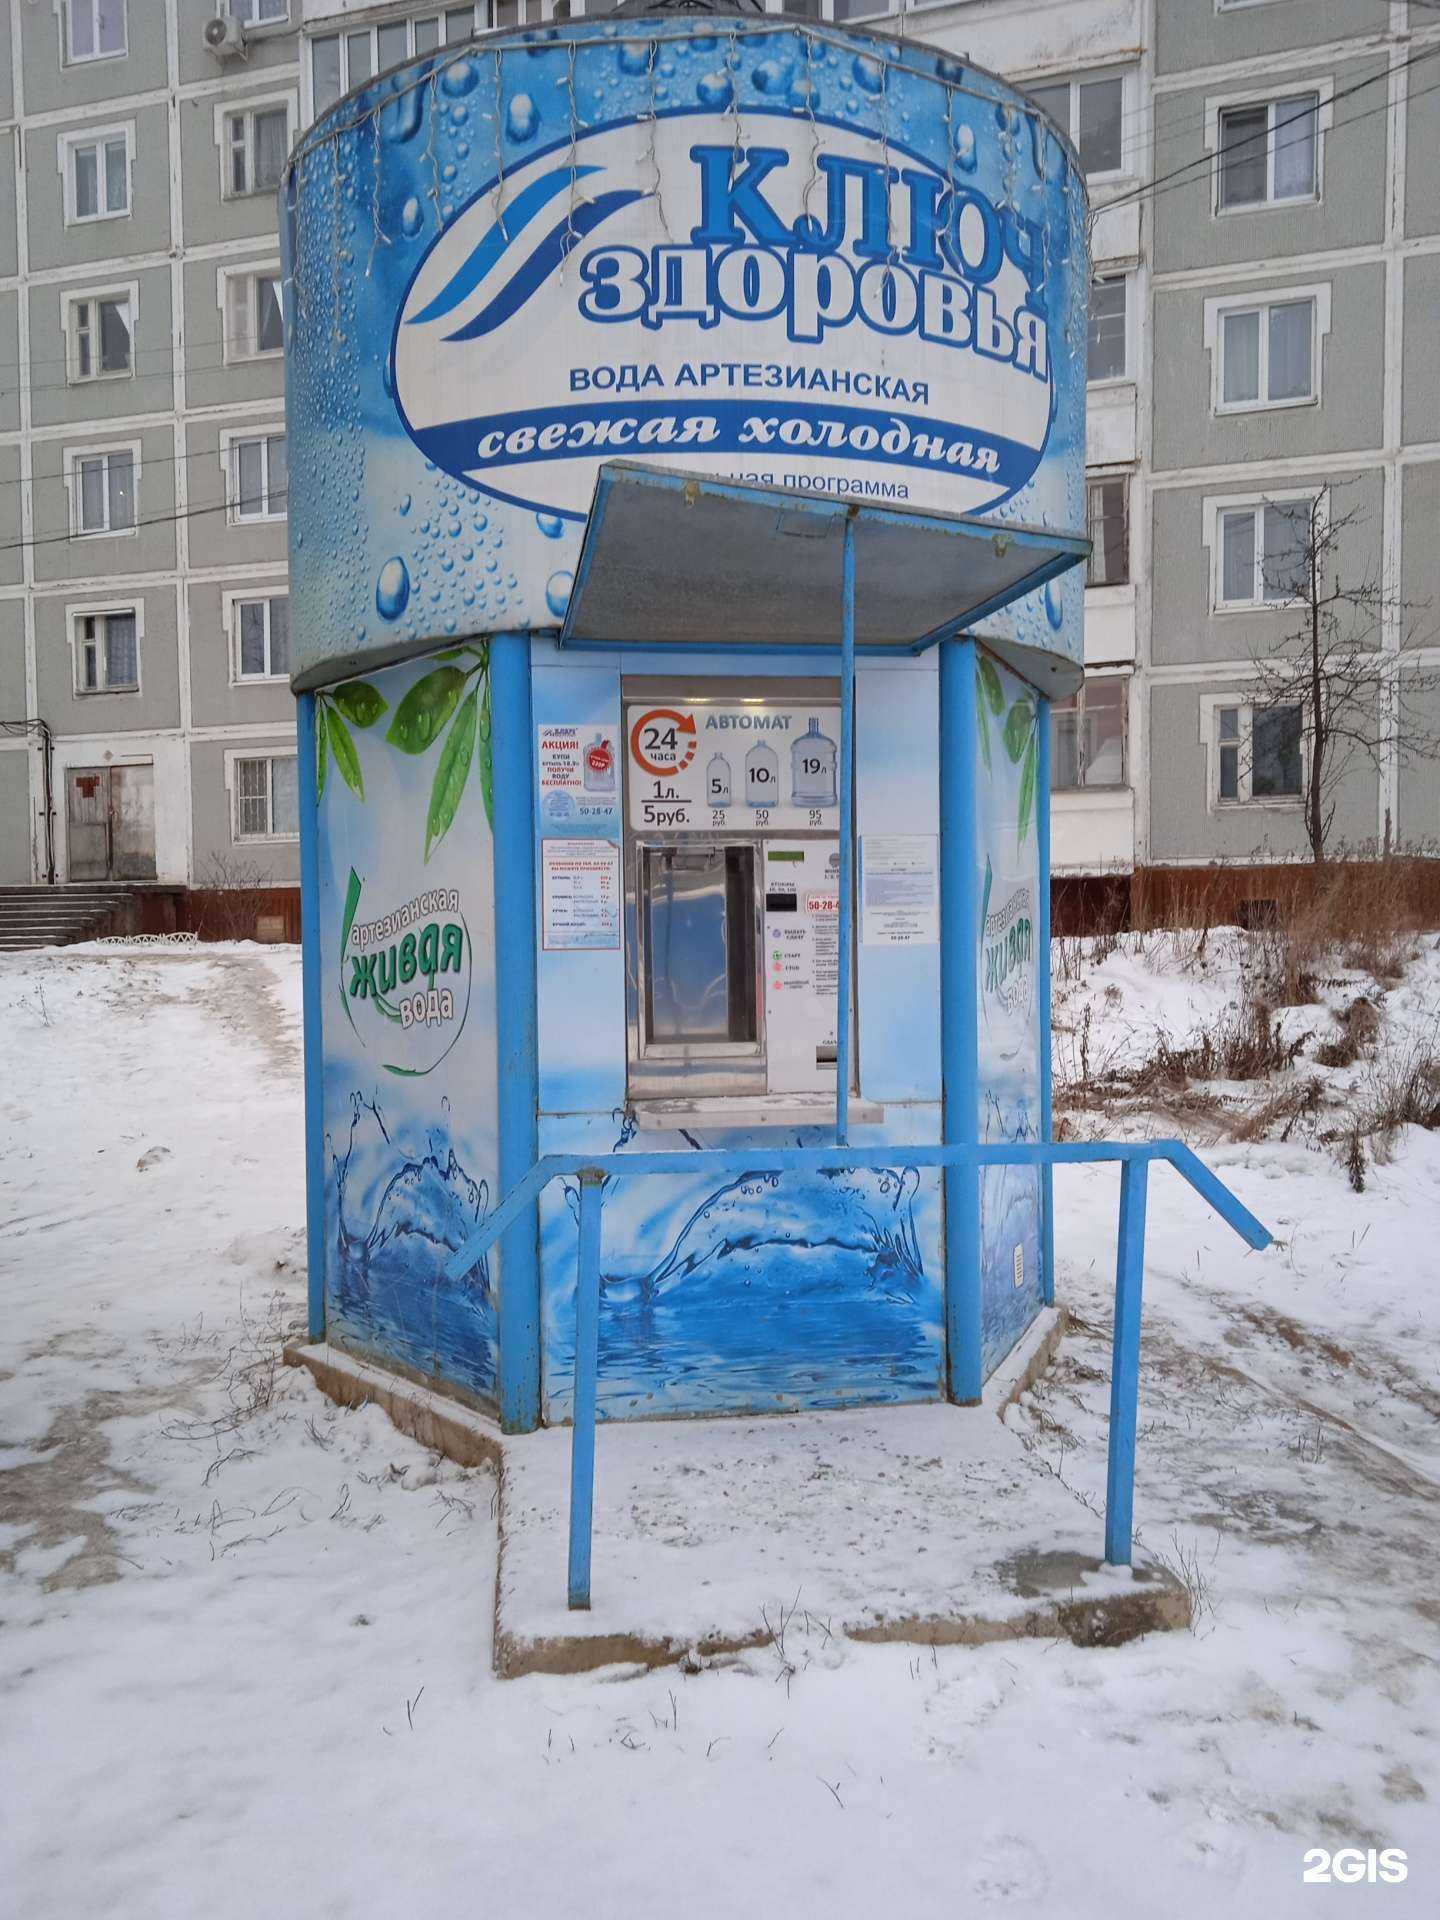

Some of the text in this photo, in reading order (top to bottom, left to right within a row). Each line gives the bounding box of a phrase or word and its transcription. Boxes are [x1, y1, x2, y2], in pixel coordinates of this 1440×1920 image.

[568, 363, 930, 405] ВОДА АРТЕЗИАНСКАЯ
[477, 412, 1002, 475] свежая холодная
[783, 474, 910, 499] программа
[705, 715, 792, 730] АВТОМАТ
[542, 741, 578, 751] АКЦИЯ!
[644, 727, 678, 750] 24
[650, 752, 676, 761] часа
[644, 805, 690, 826] 5руб.
[712, 809, 725, 820] 25
[755, 809, 769, 820] 50
[809, 809, 822, 820] 95
[351, 888, 459, 951] артезианская
[399, 988, 455, 1029] вода
